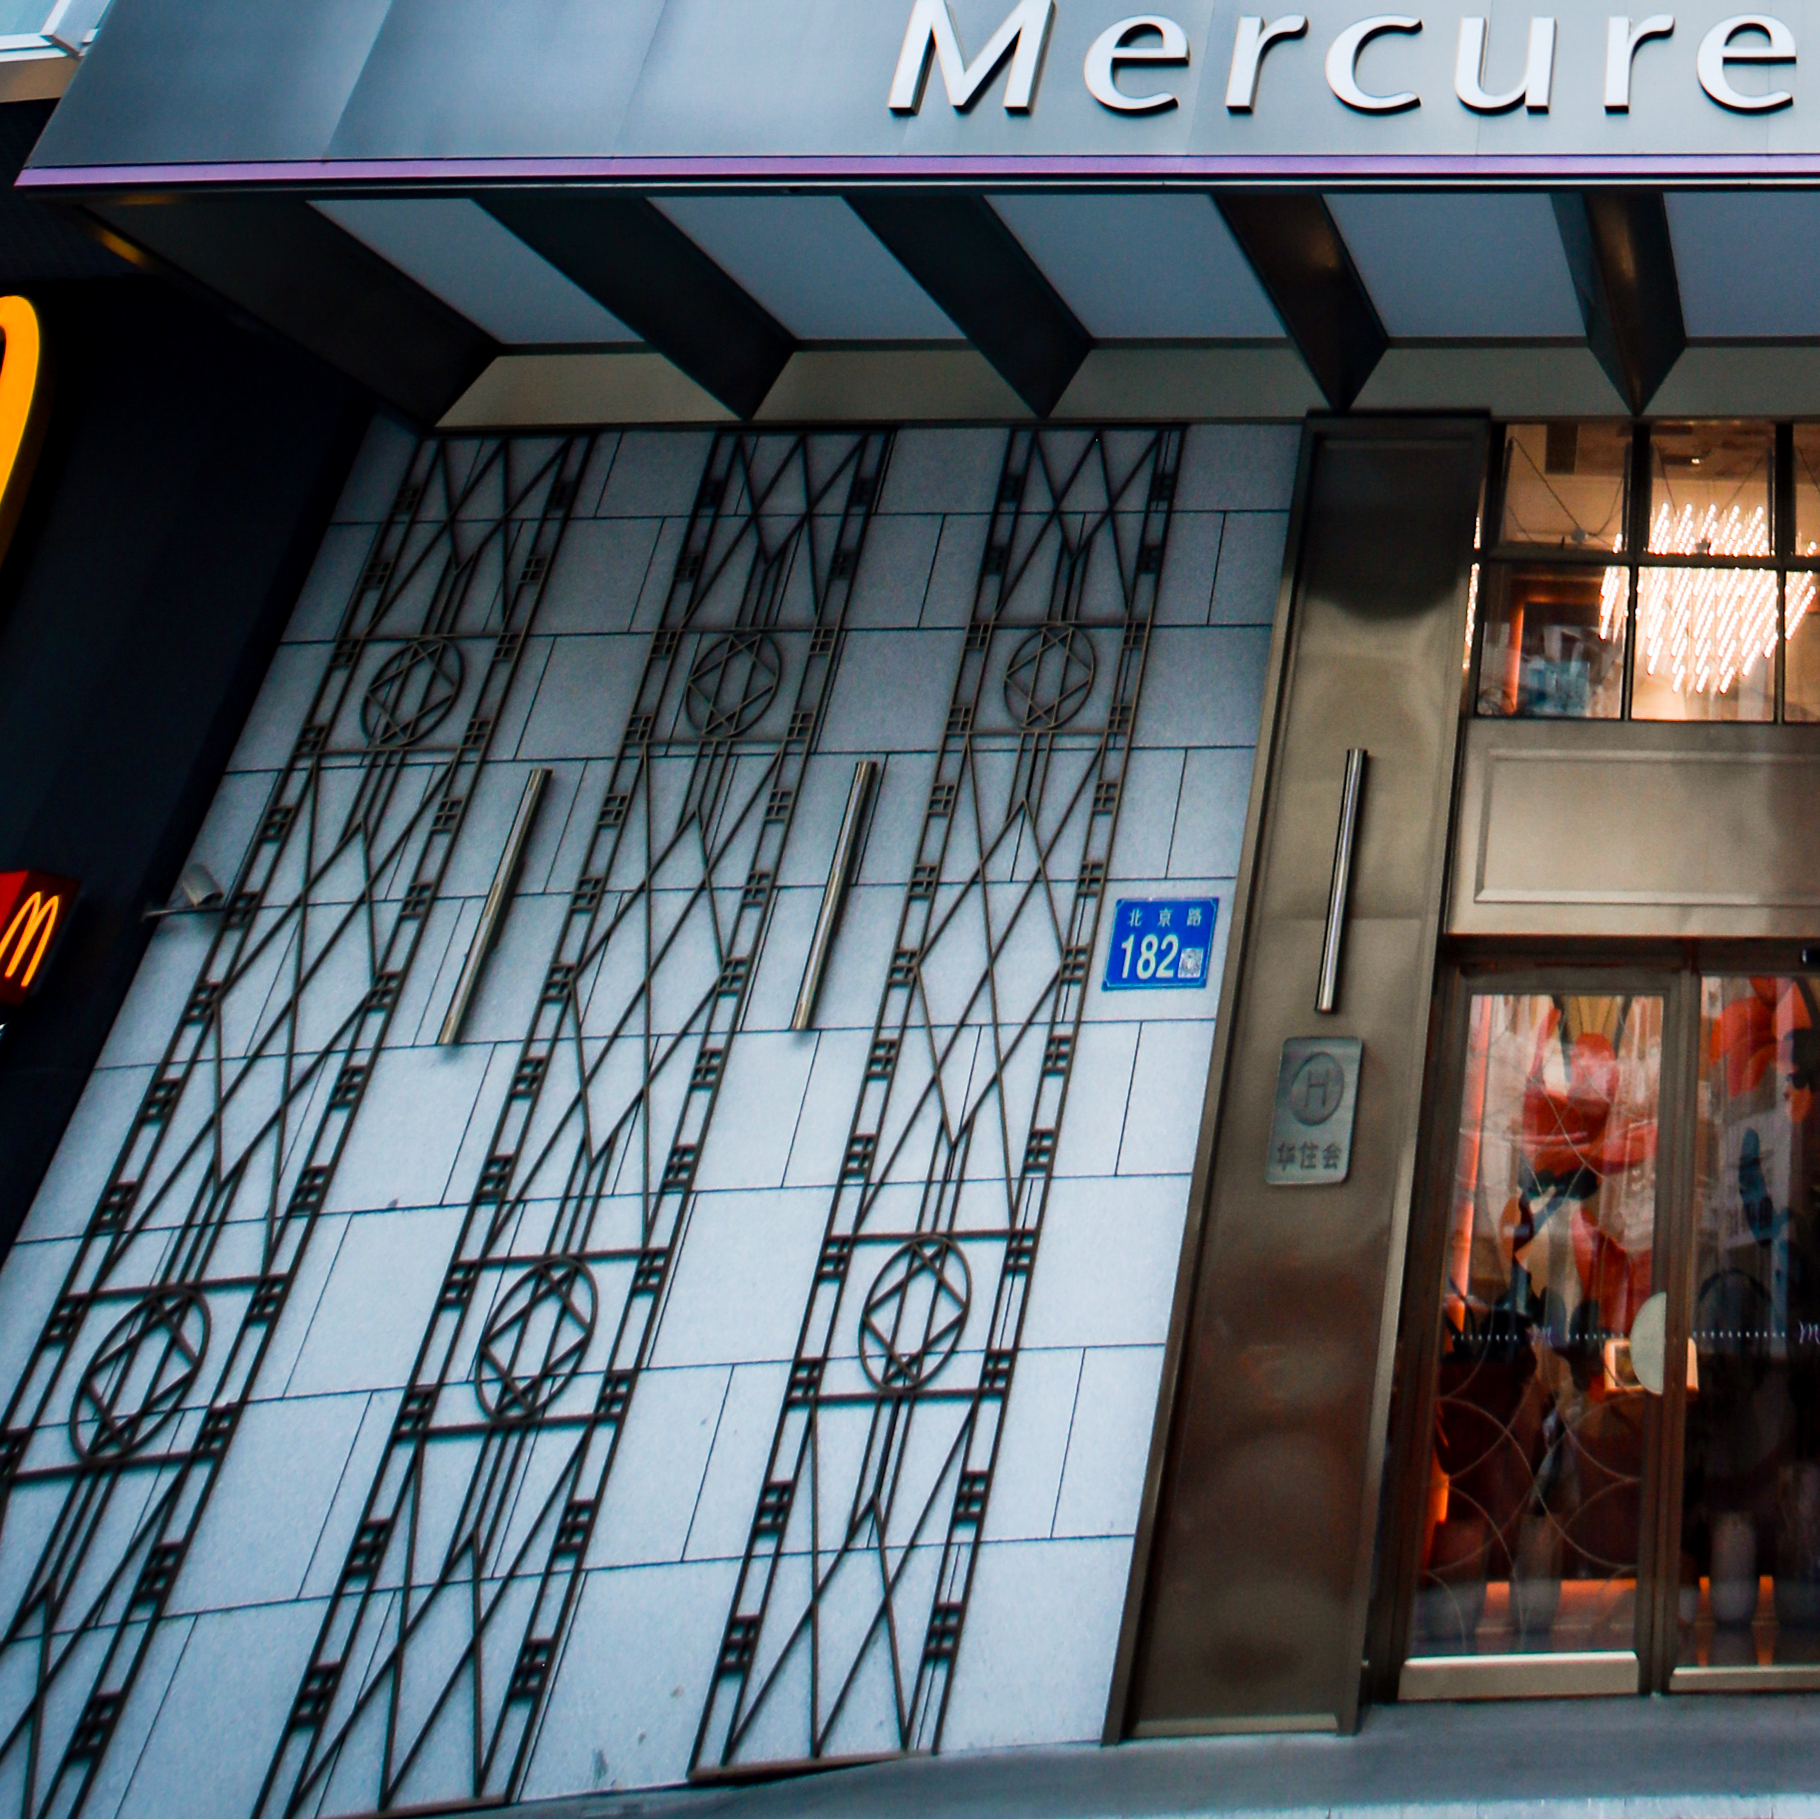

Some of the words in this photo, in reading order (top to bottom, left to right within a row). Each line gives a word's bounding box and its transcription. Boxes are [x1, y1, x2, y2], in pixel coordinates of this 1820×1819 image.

[1126, 907, 1203, 928] 北京路
[1119, 933, 1180, 980] 182
[1276, 1140, 1344, 1172] 华住会
